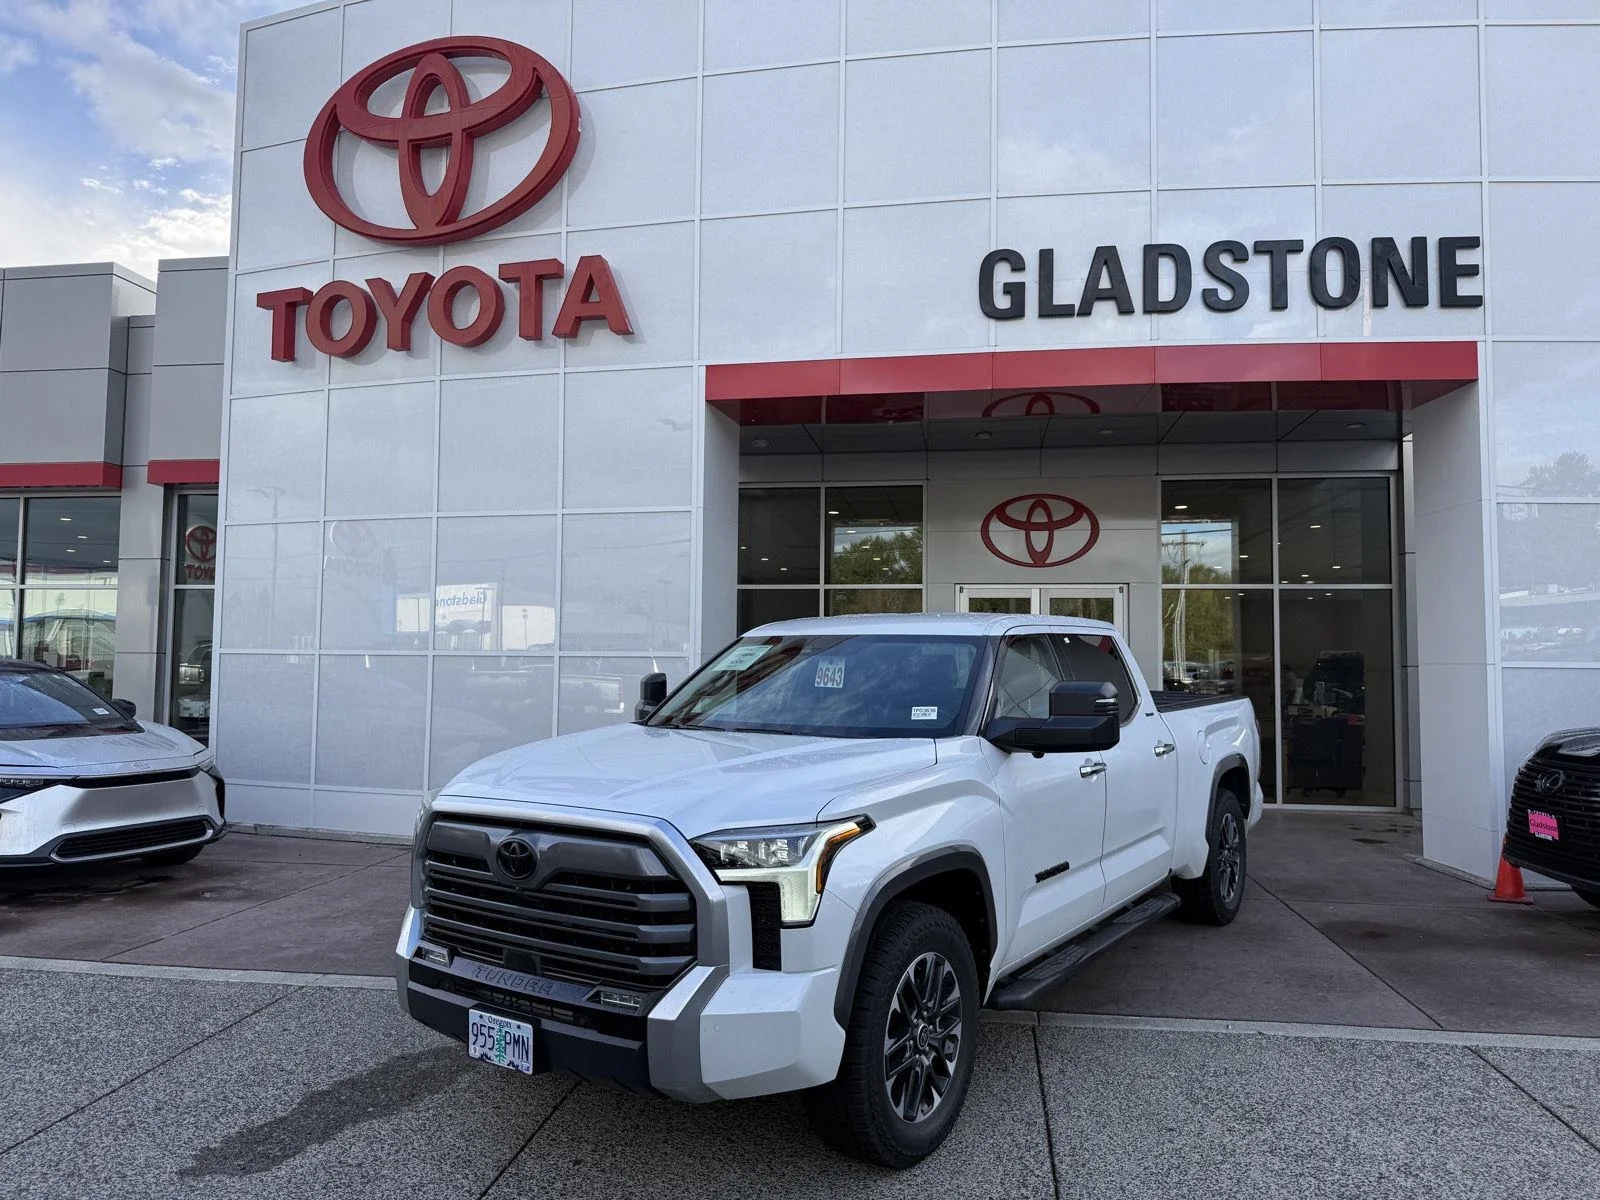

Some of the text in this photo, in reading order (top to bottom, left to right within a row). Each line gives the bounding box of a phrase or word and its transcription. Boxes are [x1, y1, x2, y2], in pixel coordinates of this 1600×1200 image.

[978, 236, 1484, 319] GLADSTONE
[257, 254, 634, 362] TOYOTA
[816, 667, 843, 687] 9643
[474, 965, 555, 996] TUNDRA
[487, 1015, 513, 1029] Oregon
[471, 1021, 530, 1062] 955 PMN
